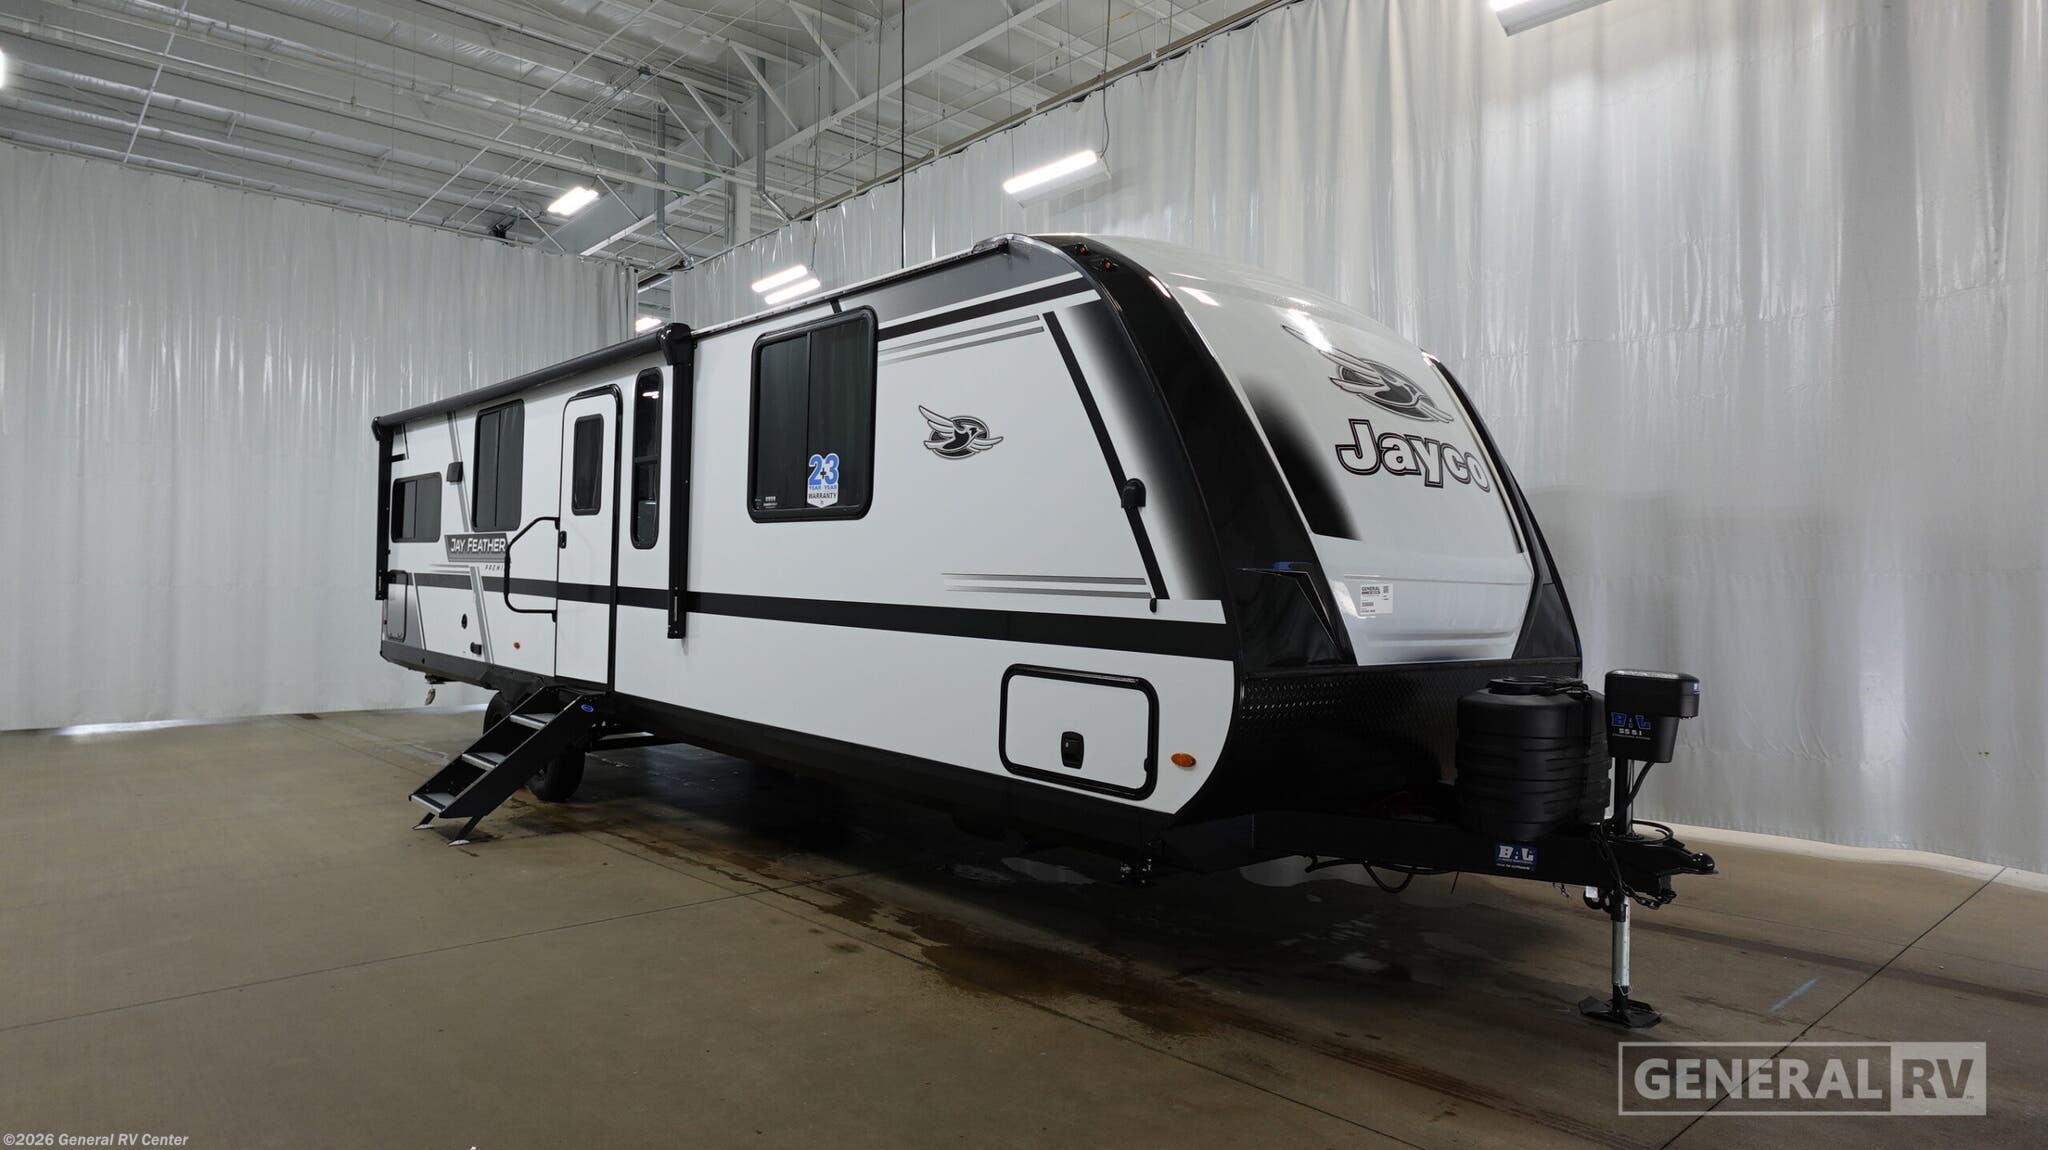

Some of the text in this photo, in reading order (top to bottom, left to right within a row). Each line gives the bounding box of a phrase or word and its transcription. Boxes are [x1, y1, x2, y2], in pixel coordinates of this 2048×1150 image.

[1335, 418, 1490, 492] Jayco
[450, 537, 506, 552] JAY FEATHER
